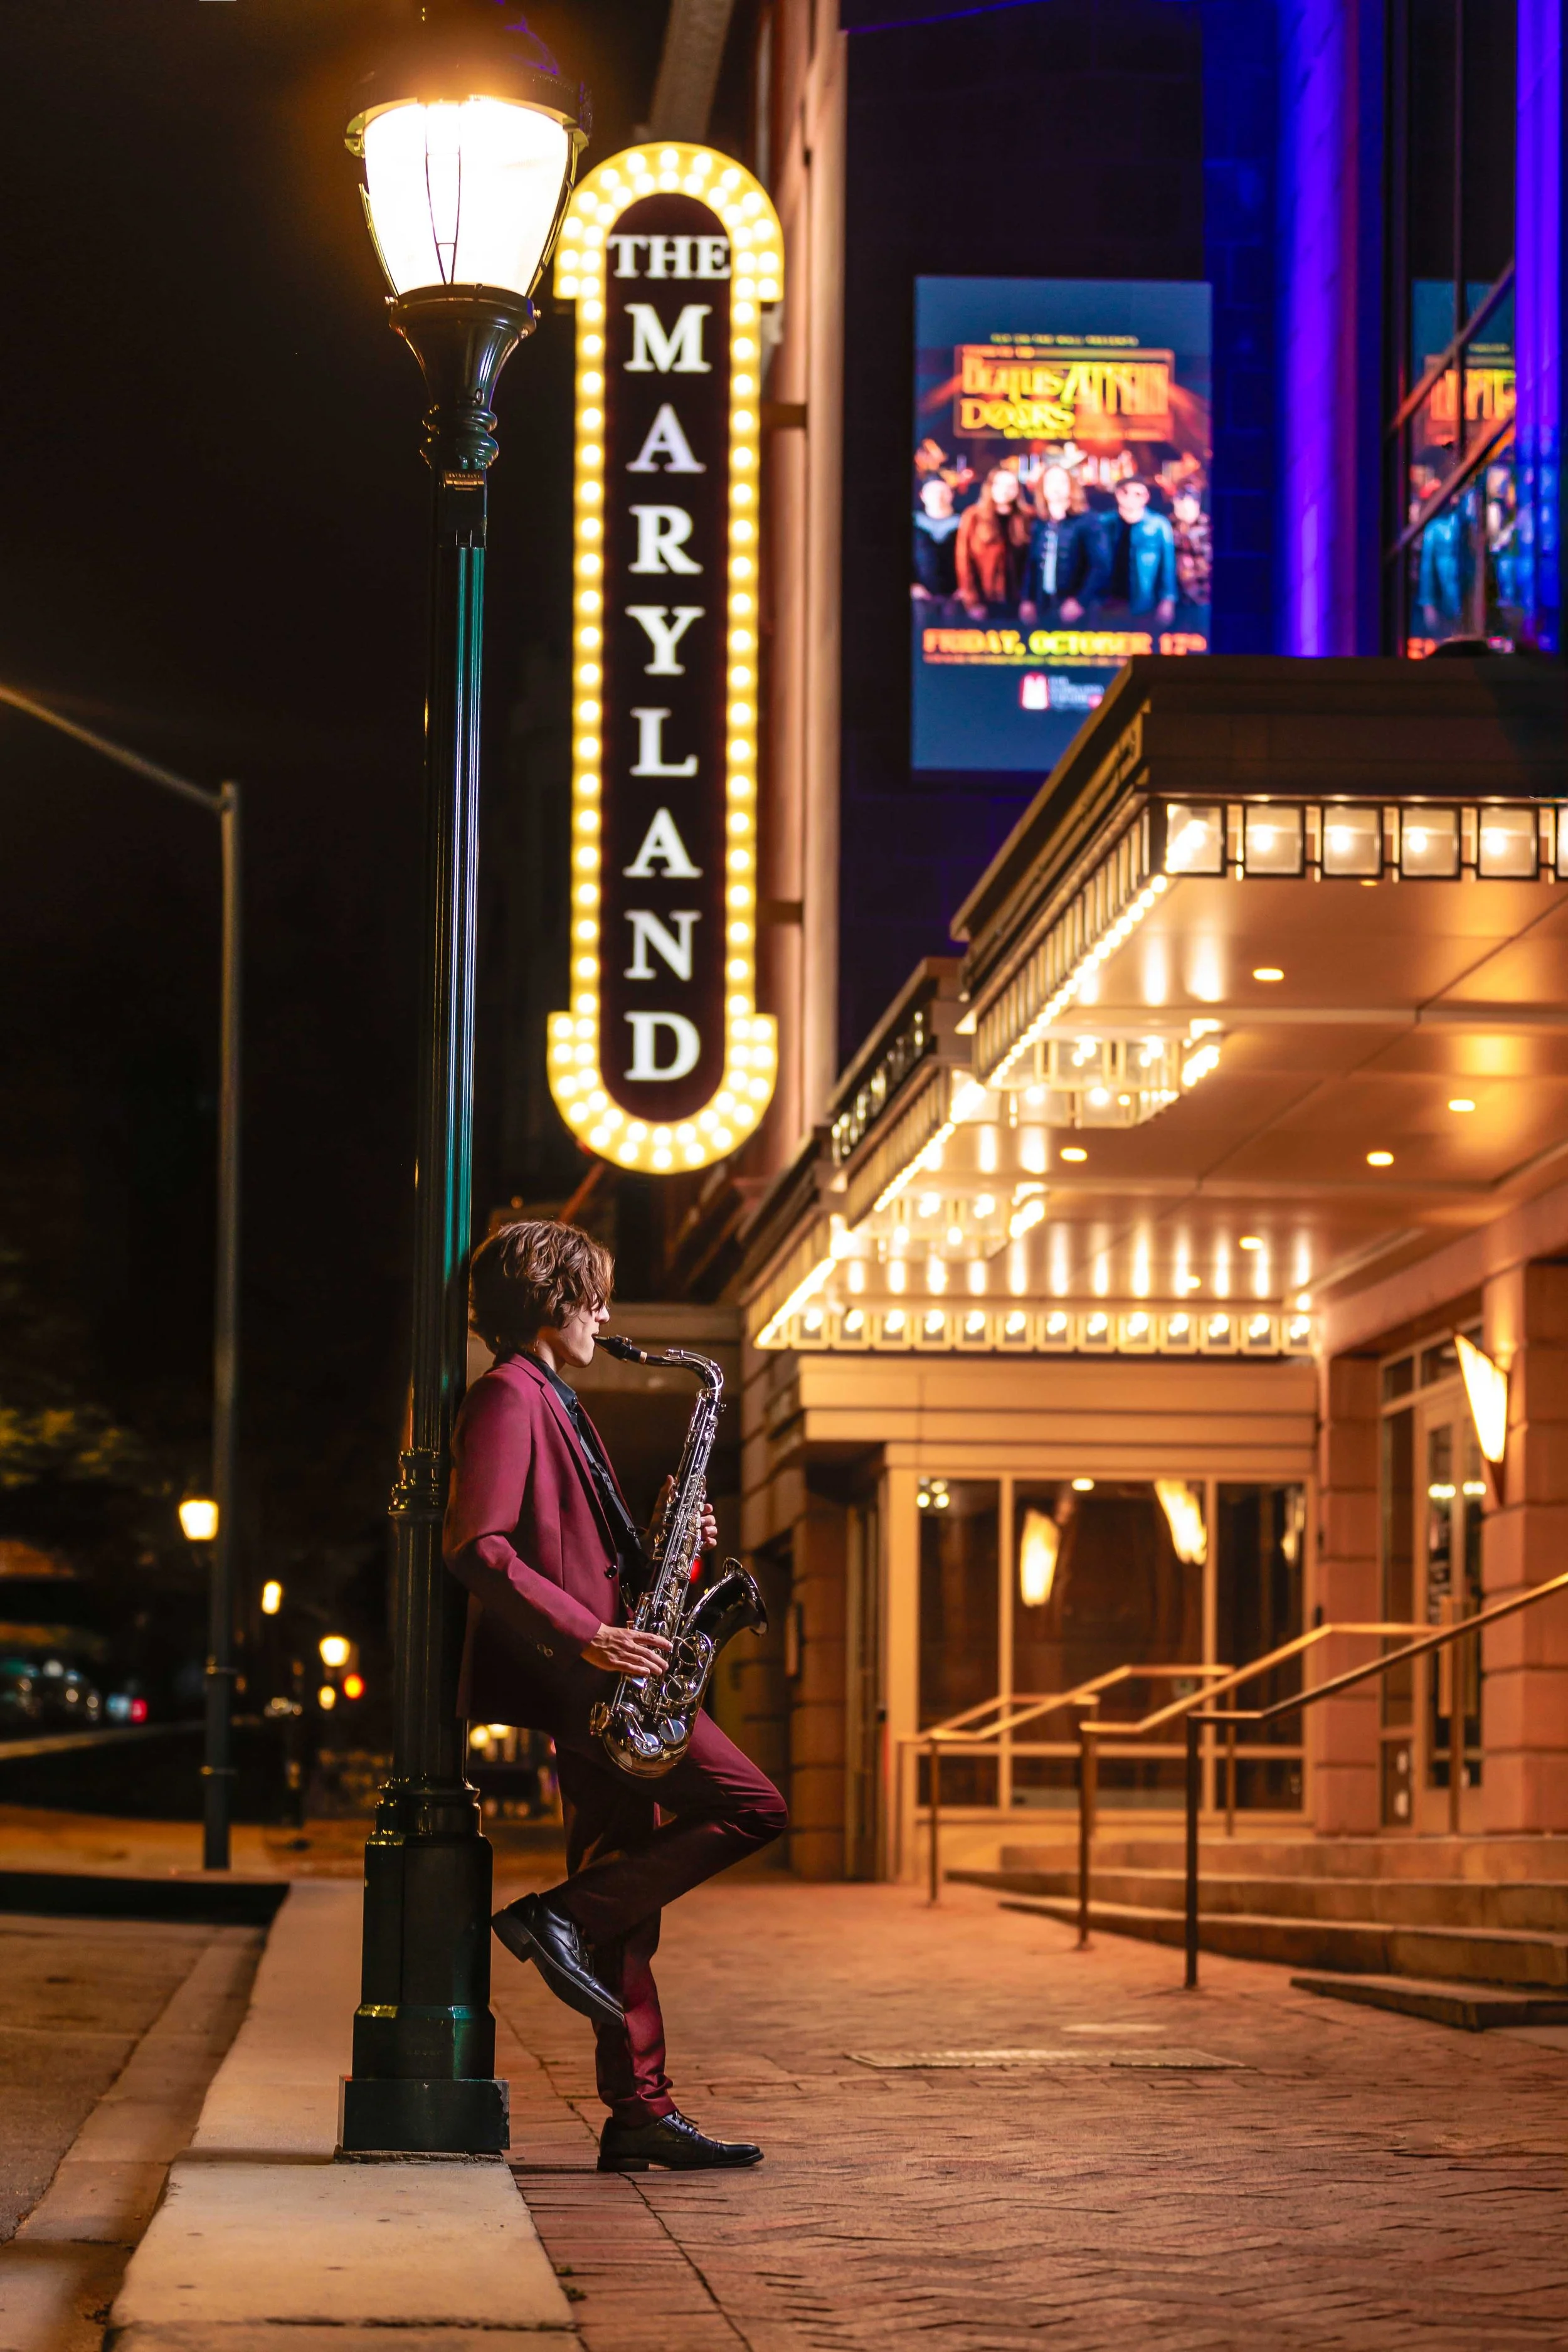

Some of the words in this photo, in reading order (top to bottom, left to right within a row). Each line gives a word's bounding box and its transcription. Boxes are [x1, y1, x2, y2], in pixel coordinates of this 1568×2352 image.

[607, 234, 733, 279] THE
[1029, 630, 1152, 655] OCTOBER
[623, 302, 711, 1082] MARYLAND
